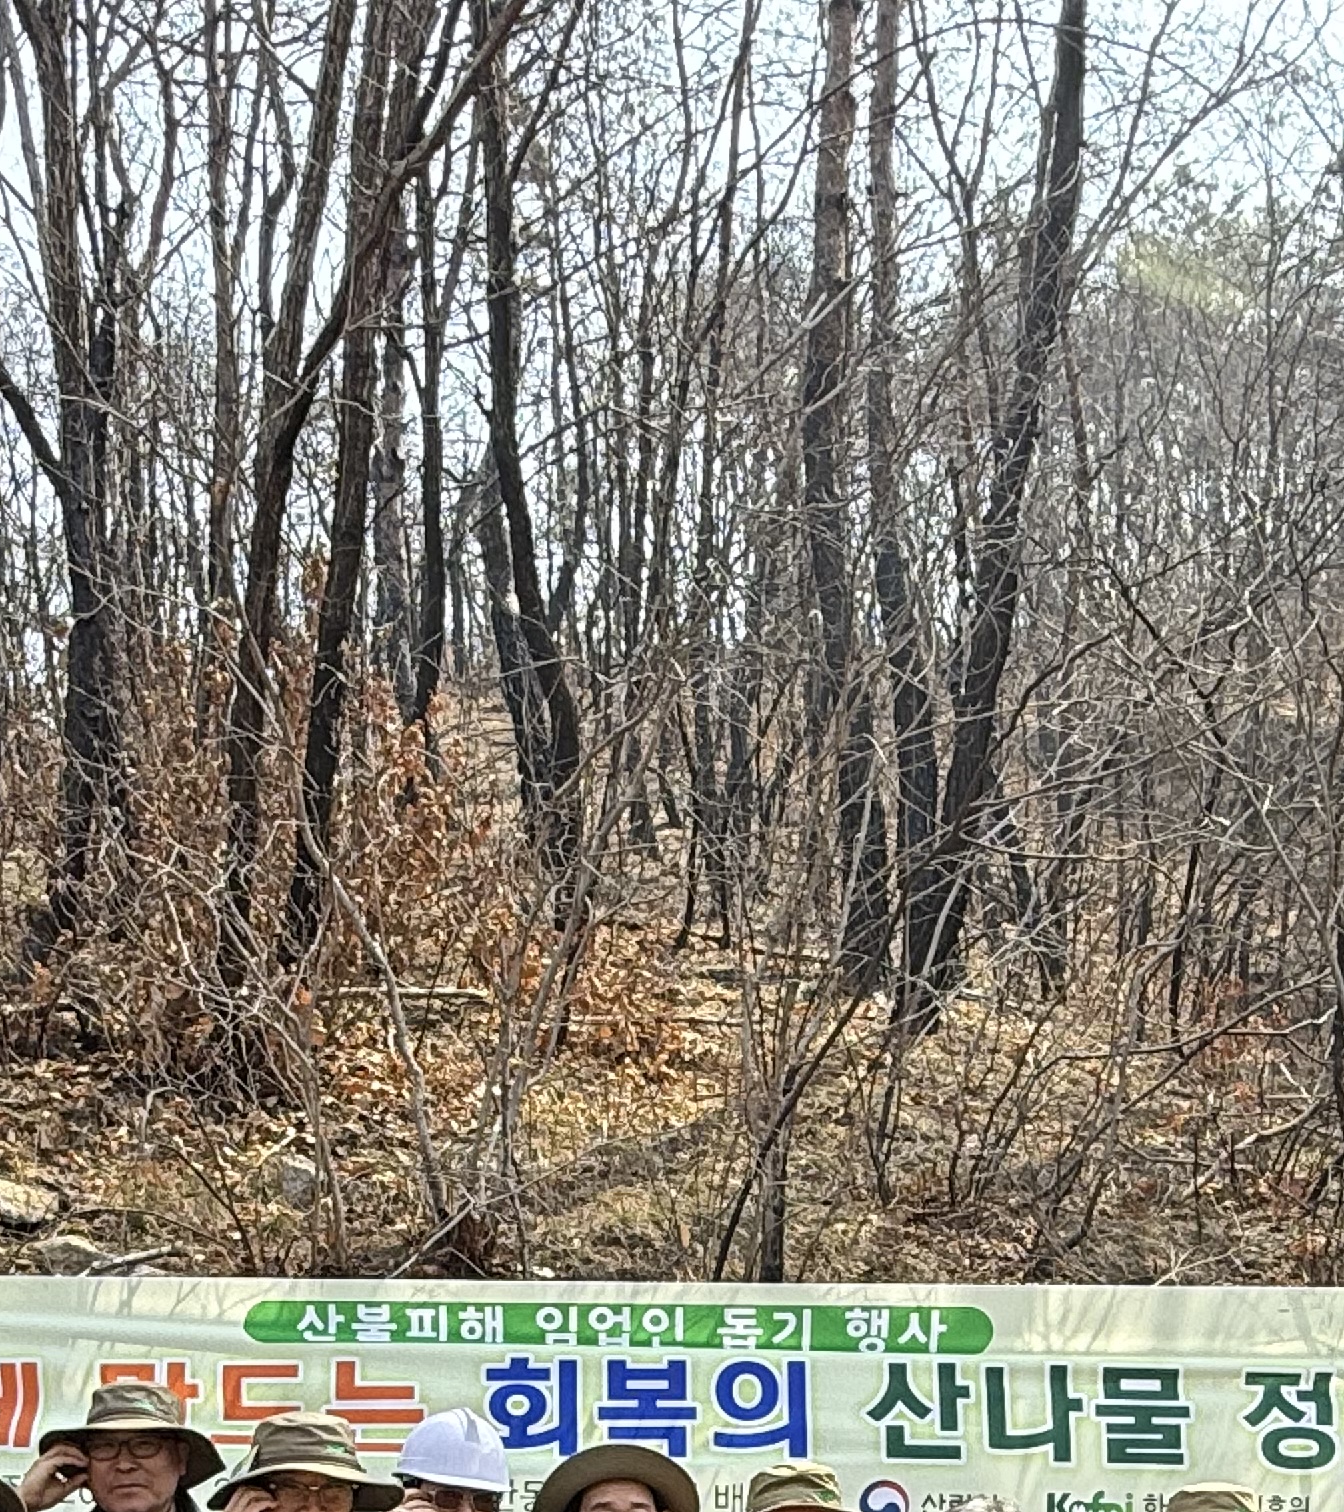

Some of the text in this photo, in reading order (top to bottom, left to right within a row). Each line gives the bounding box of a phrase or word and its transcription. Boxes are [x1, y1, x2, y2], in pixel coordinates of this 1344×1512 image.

[296, 1303, 948, 1353] 산불피해 임업인 돕기 행사
[487, 1357, 807, 1457] 회복의
[866, 1363, 1190, 1465] 산나물
